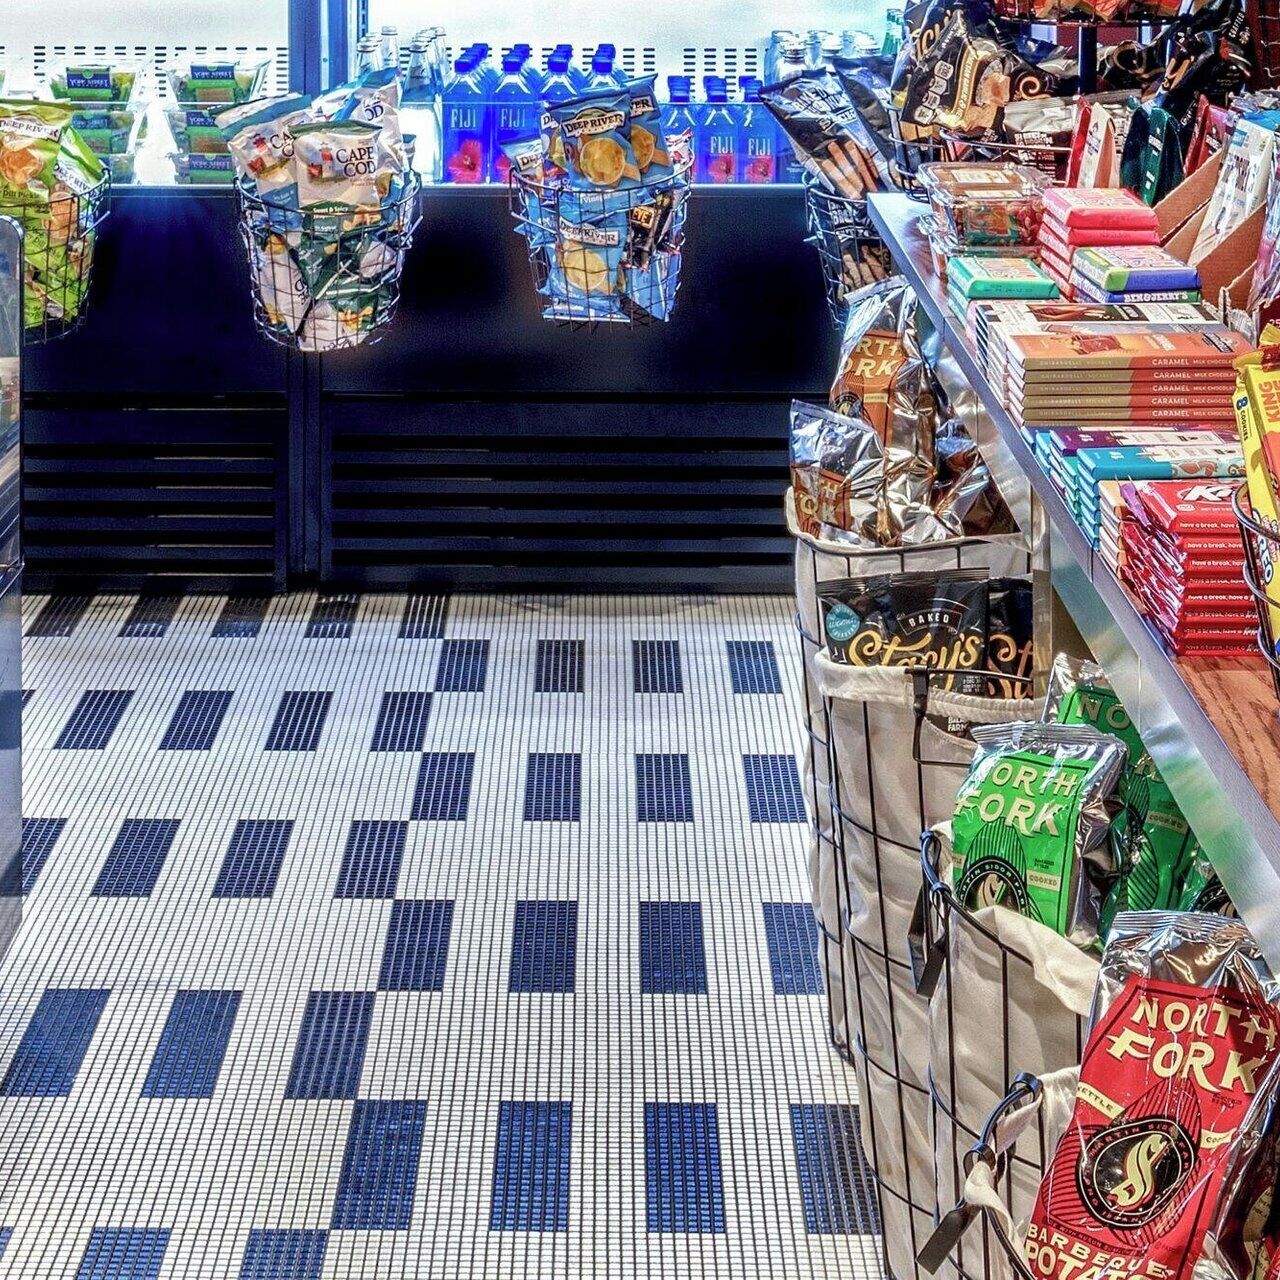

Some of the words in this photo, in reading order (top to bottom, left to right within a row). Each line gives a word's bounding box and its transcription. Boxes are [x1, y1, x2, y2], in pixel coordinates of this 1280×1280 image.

[1229, 11, 1246, 38] CRAFTED
[451, 107, 475, 128] FIJI
[500, 107, 524, 128] FIJI
[336, 146, 374, 164] CAPE
[710, 136, 734, 156] FIJI
[748, 138, 772, 159] FIJI
[845, 357, 899, 379] ORK
[908, 613, 949, 625] BAKED
[976, 756, 1080, 799] NORTH
[954, 792, 1066, 838] FORK
[1132, 995, 1279, 1051] NORTH
[1107, 1026, 1264, 1097] FORK
[1025, 1222, 1176, 1279] BARBEQUE
